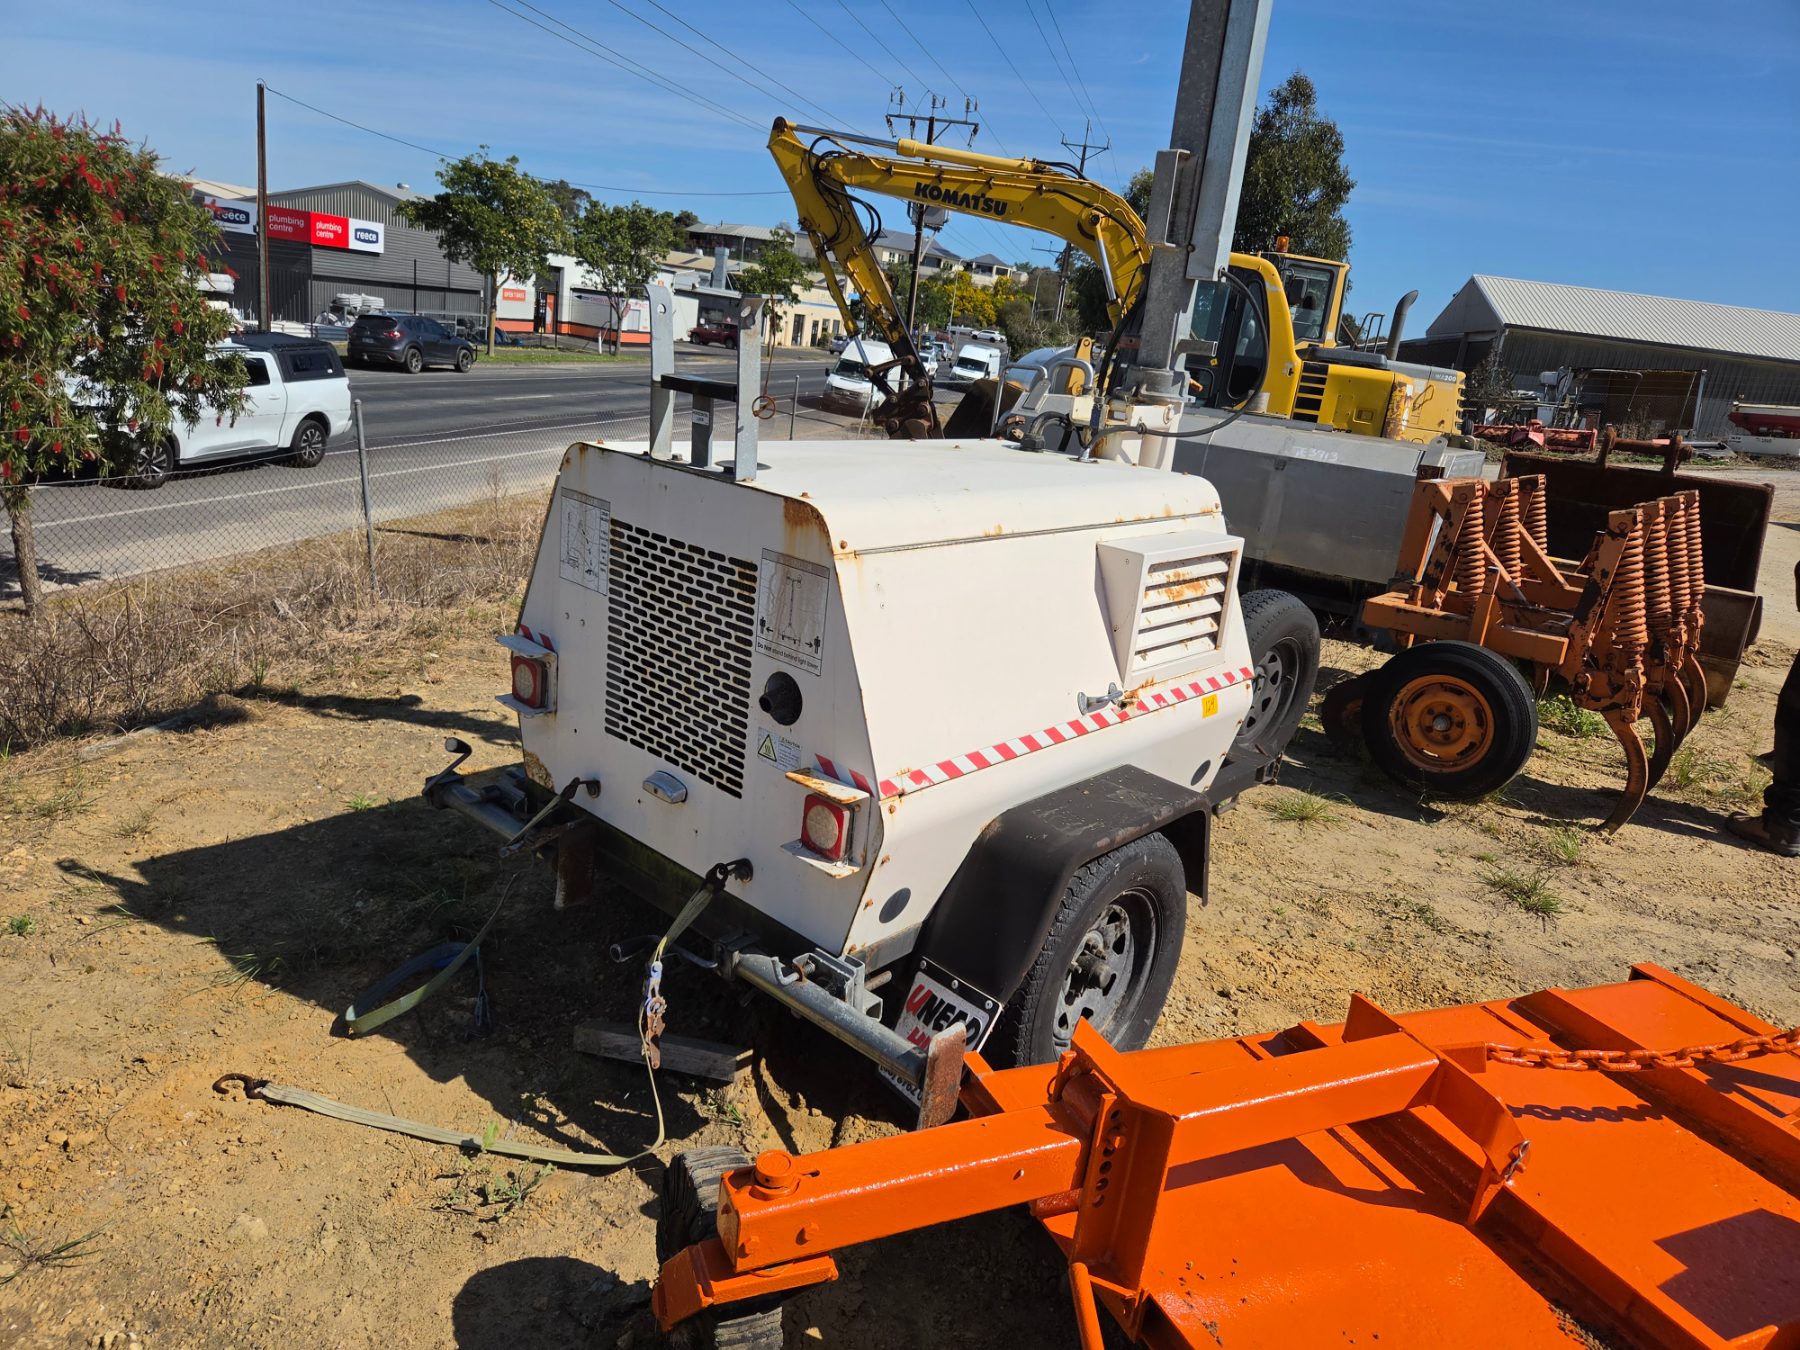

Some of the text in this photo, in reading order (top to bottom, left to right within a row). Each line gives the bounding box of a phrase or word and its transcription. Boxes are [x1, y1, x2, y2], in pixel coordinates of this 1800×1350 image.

[914, 182, 1008, 216] KOMATSU
[216, 210, 247, 222] eece
[268, 213, 305, 229] plumbing
[268, 223, 294, 233] centre
[315, 221, 342, 234] plumbing
[315, 229, 335, 240] centre
[356, 231, 378, 242] reece
